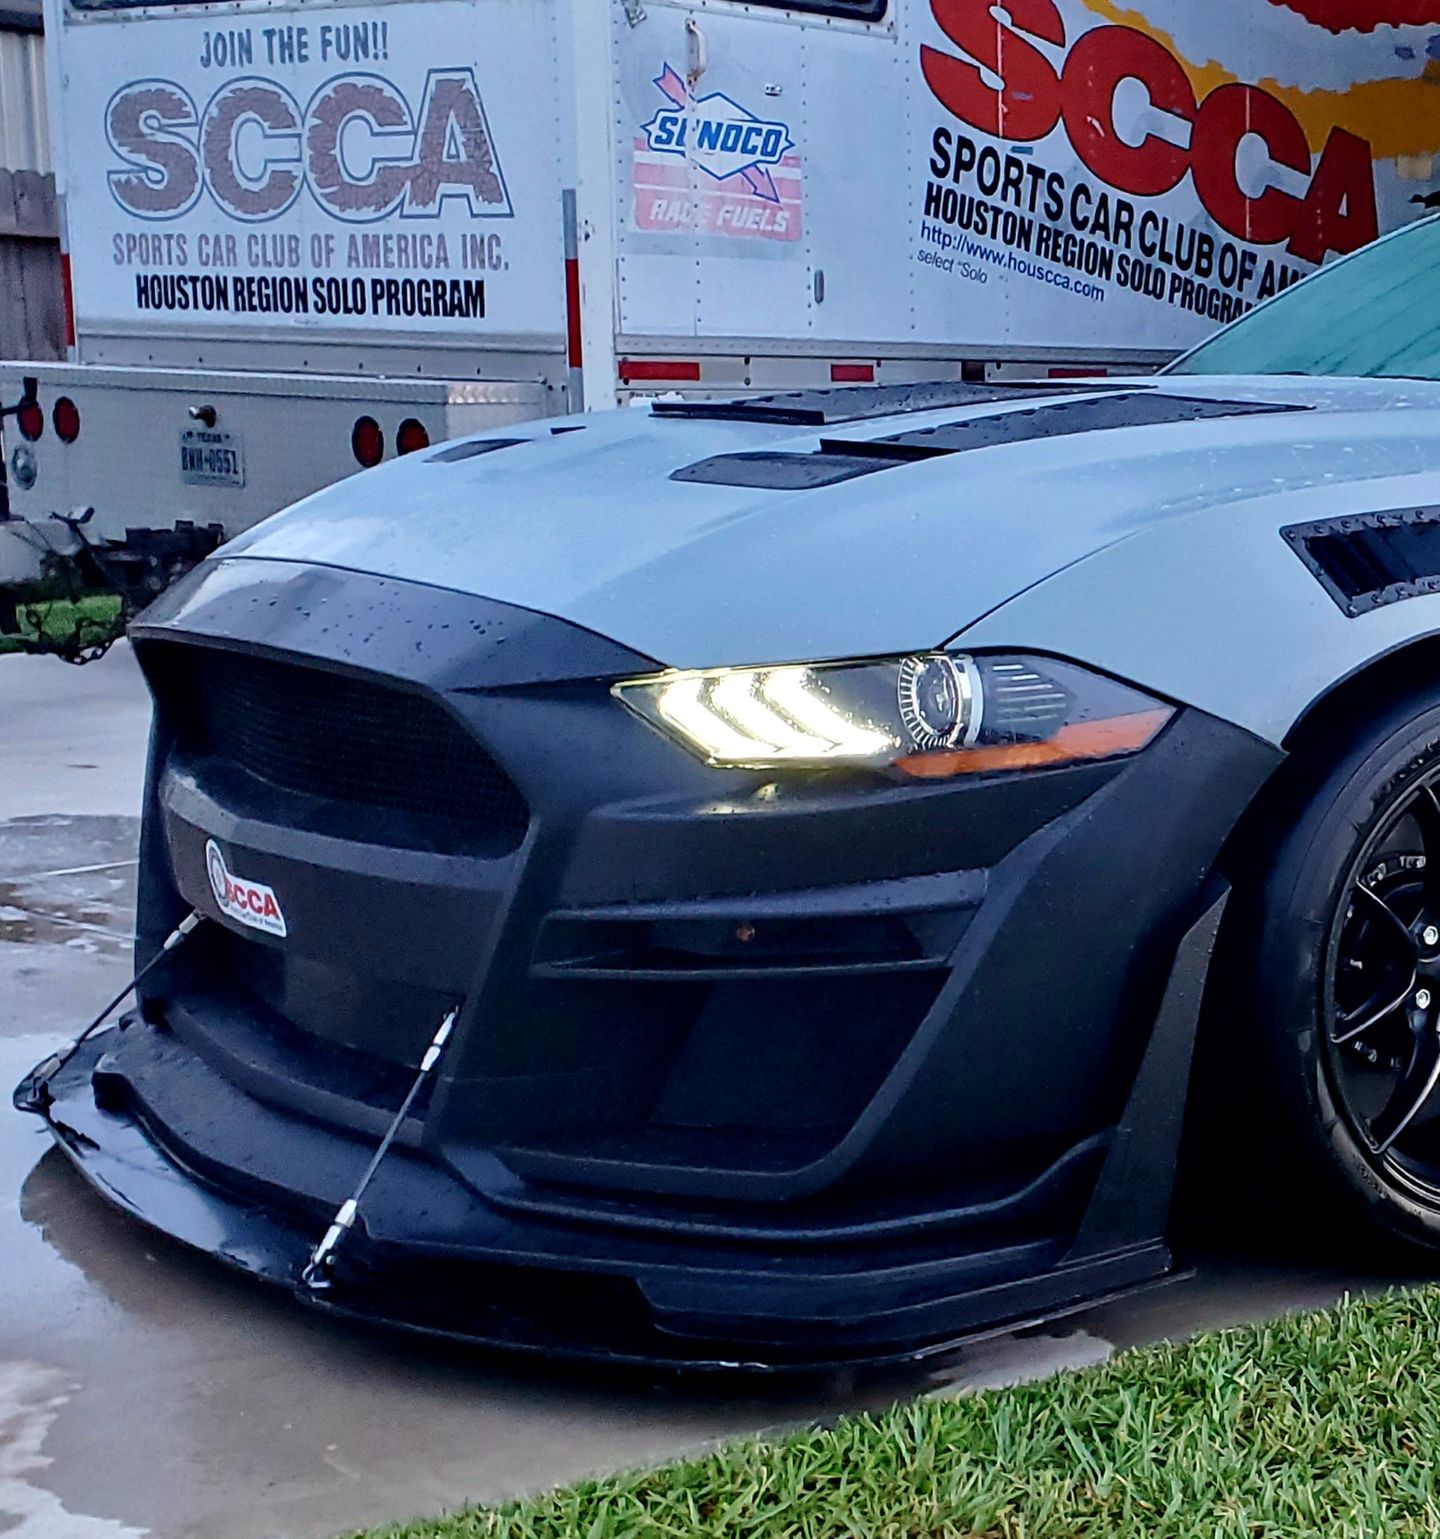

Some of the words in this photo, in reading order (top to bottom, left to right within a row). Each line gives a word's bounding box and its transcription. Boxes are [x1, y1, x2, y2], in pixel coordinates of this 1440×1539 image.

[200, 28, 253, 68] JOIN
[262, 26, 309, 65] THE
[320, 21, 388, 62] FUN!!
[104, 67, 515, 224] SCCA
[716, 204, 790, 232] FUELS
[929, 126, 1065, 222] SPORTS
[1070, 182, 1135, 250] CAR
[1138, 210, 1214, 278] CLUB
[1218, 242, 1258, 292] OF
[113, 232, 188, 267] SPORTS
[198, 233, 238, 267] CAR
[247, 233, 300, 268] CLUB
[310, 233, 335, 268] OF
[347, 233, 450, 269] AMERICA
[461, 233, 509, 271] INC.
[917, 249, 954, 273] select
[920, 220, 1105, 302] http://www.houscca.com
[923, 181, 1033, 252] HOUSTON
[1034, 222, 1114, 281] REGION
[1116, 253, 1166, 300] SOLO
[1168, 272, 1258, 324] PROGRA
[136, 272, 229, 311] HOUSTON
[232, 276, 309, 314] REGION
[312, 276, 366, 315] SOLO
[371, 278, 485, 318] PROGRAM
